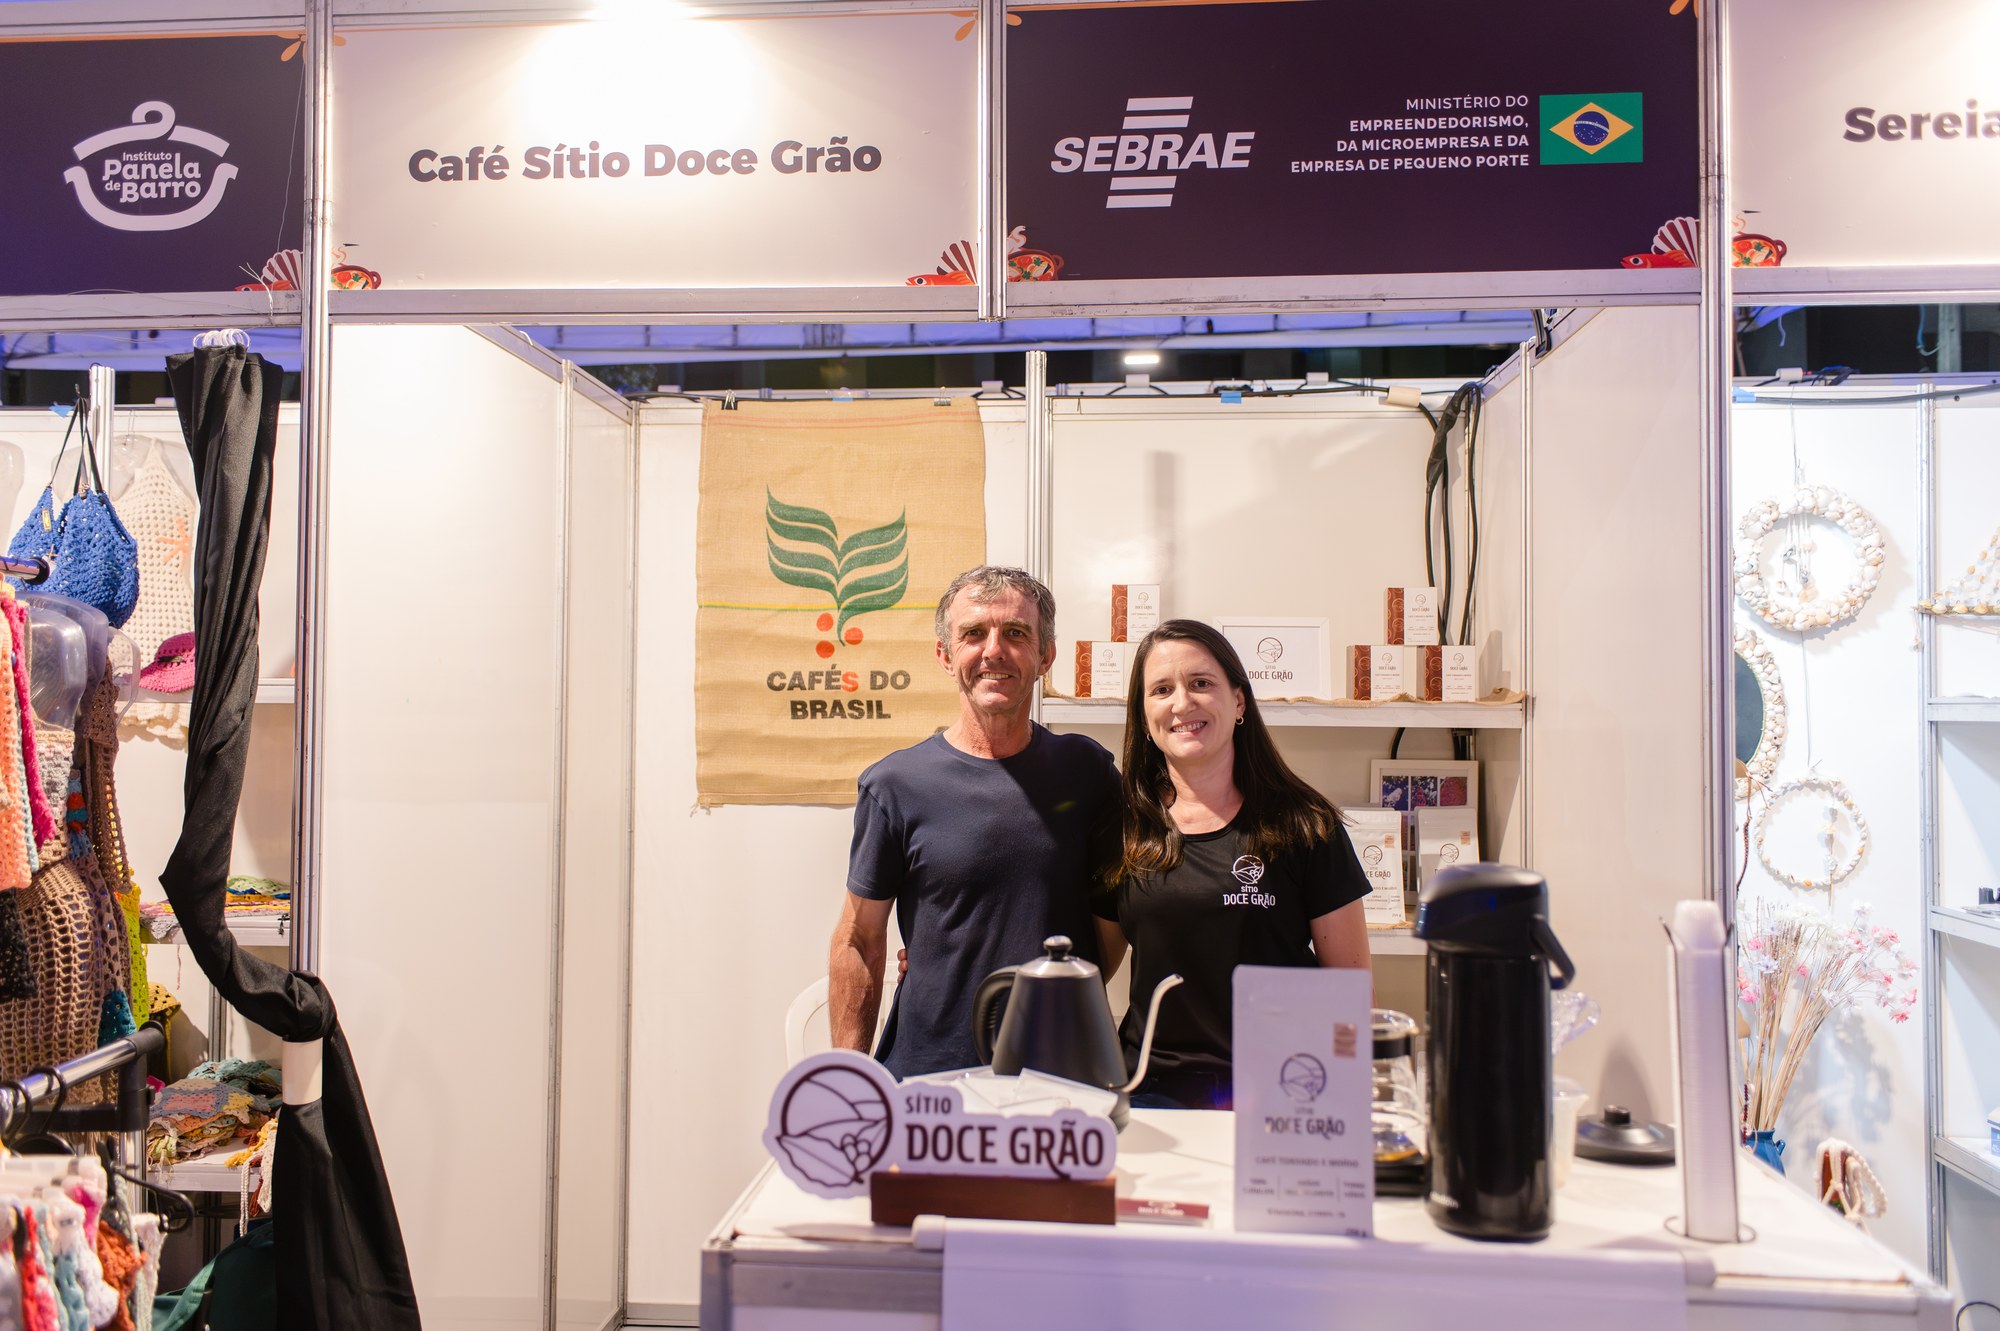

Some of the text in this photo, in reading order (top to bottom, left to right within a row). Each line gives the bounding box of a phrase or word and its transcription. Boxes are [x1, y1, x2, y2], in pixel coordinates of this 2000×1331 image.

[1406, 94, 1529, 110] MINISTÉRIO DO
[1349, 115, 1529, 132] EMPREENDEDORISMO,
[1842, 98, 2000, 143] Sereia
[1050, 131, 1256, 174] SEBRAE
[1336, 134, 1530, 152] DA MICROEMPRESA E DA
[102, 152, 202, 181] Panela
[122, 151, 173, 161] Instituto
[408, 135, 883, 183] Café Sítio Doce Grão
[1290, 154, 1530, 173] EMPRESA DE PEQUENO PORTE
[104, 180, 202, 203] de Barro
[766, 663, 912, 692] CAFÉS DO
[1248, 669, 1294, 682] DOCE GRÃO
[790, 699, 892, 720] BRASIL
[1240, 884, 1259, 893] SÍTIO
[1222, 892, 1276, 909] DOCE GRÃO
[905, 1092, 953, 1115] SÍTIO
[905, 1119, 1105, 1180] DOCE GRÃO
